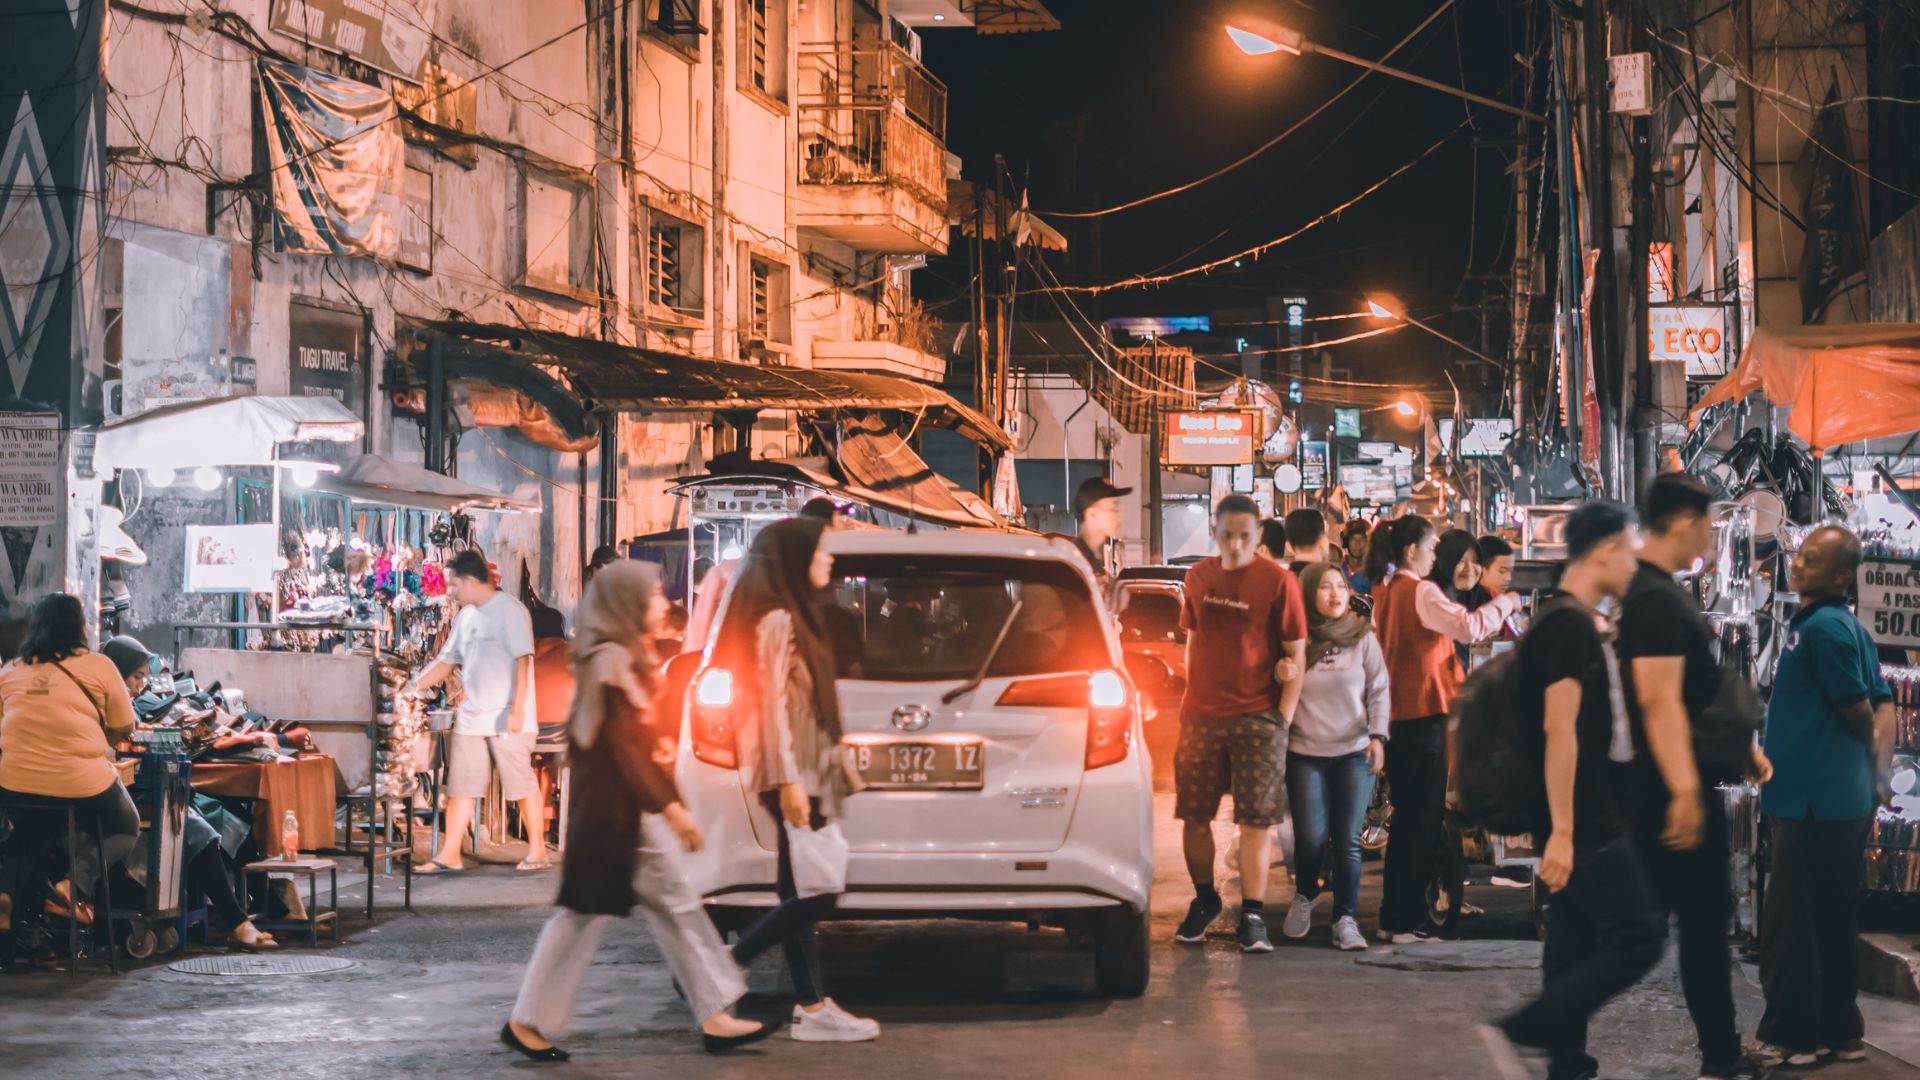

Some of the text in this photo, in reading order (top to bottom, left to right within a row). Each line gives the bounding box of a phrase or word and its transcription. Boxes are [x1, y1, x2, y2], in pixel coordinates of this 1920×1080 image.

[1664, 327, 1721, 354] ECO
[300, 346, 349, 372] TUGU TRAVEL
[20, 429, 55, 441] MOBIL
[20, 482, 54, 495] MOBIL
[1882, 592, 1892, 606] 4
[888, 745, 936, 770] 1372
